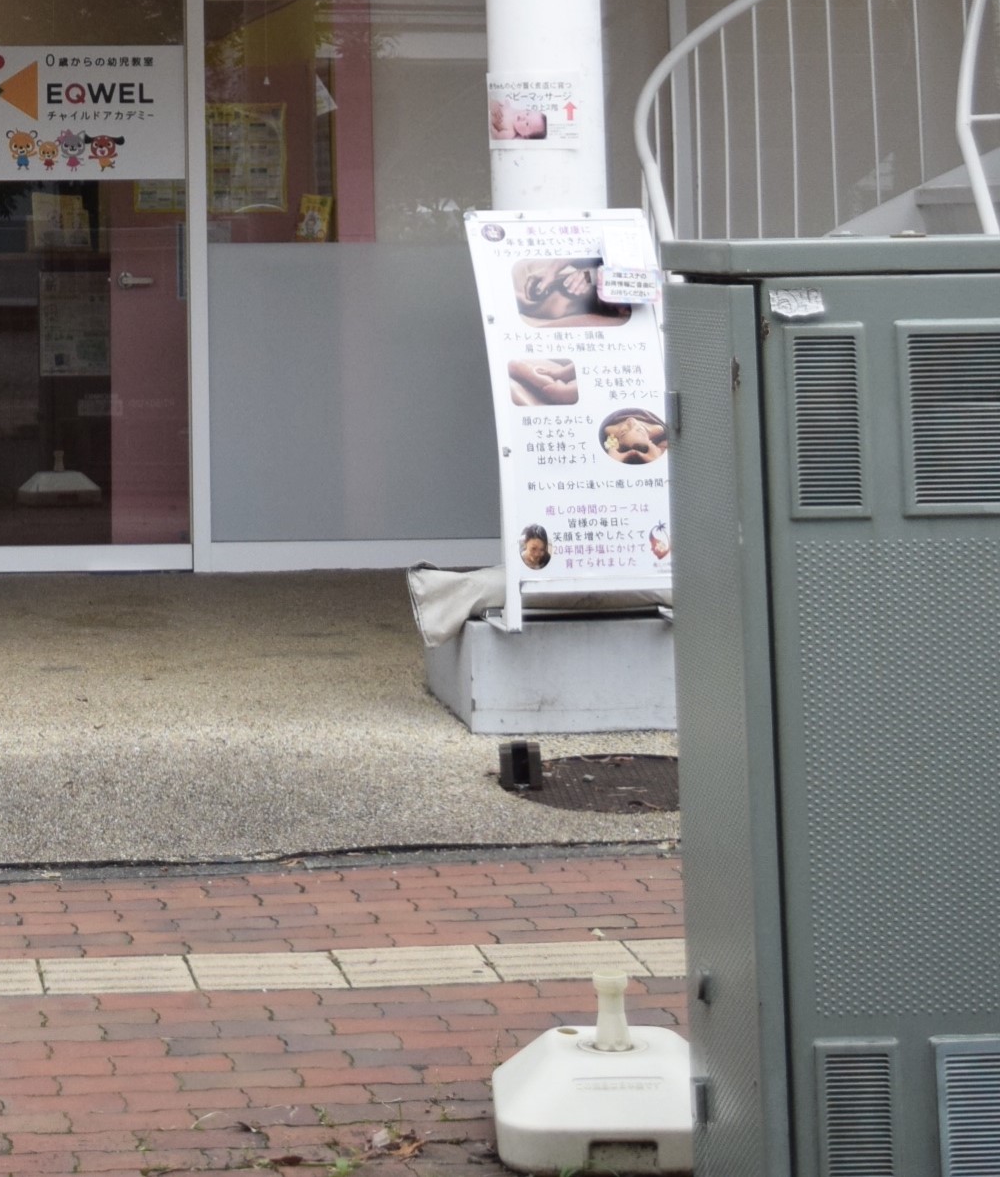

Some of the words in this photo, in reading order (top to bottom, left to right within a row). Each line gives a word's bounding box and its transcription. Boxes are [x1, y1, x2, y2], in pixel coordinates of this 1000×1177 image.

[46, 53, 154, 67] 0歳からの幼児教室
[46, 83, 154, 104] EQWEL
[505, 92, 572, 101] ベビーマッサージ
[47, 110, 154, 121] チャイルドアカデミー
[535, 429, 576, 438] さよなら
[526, 441, 587, 452] 自信を持って
[545, 503, 649, 516] 癒しの時間のコースは
[567, 517, 629, 529] 皆様の毎日に
[553, 530, 646, 542] 笑顔を増やしたくて
